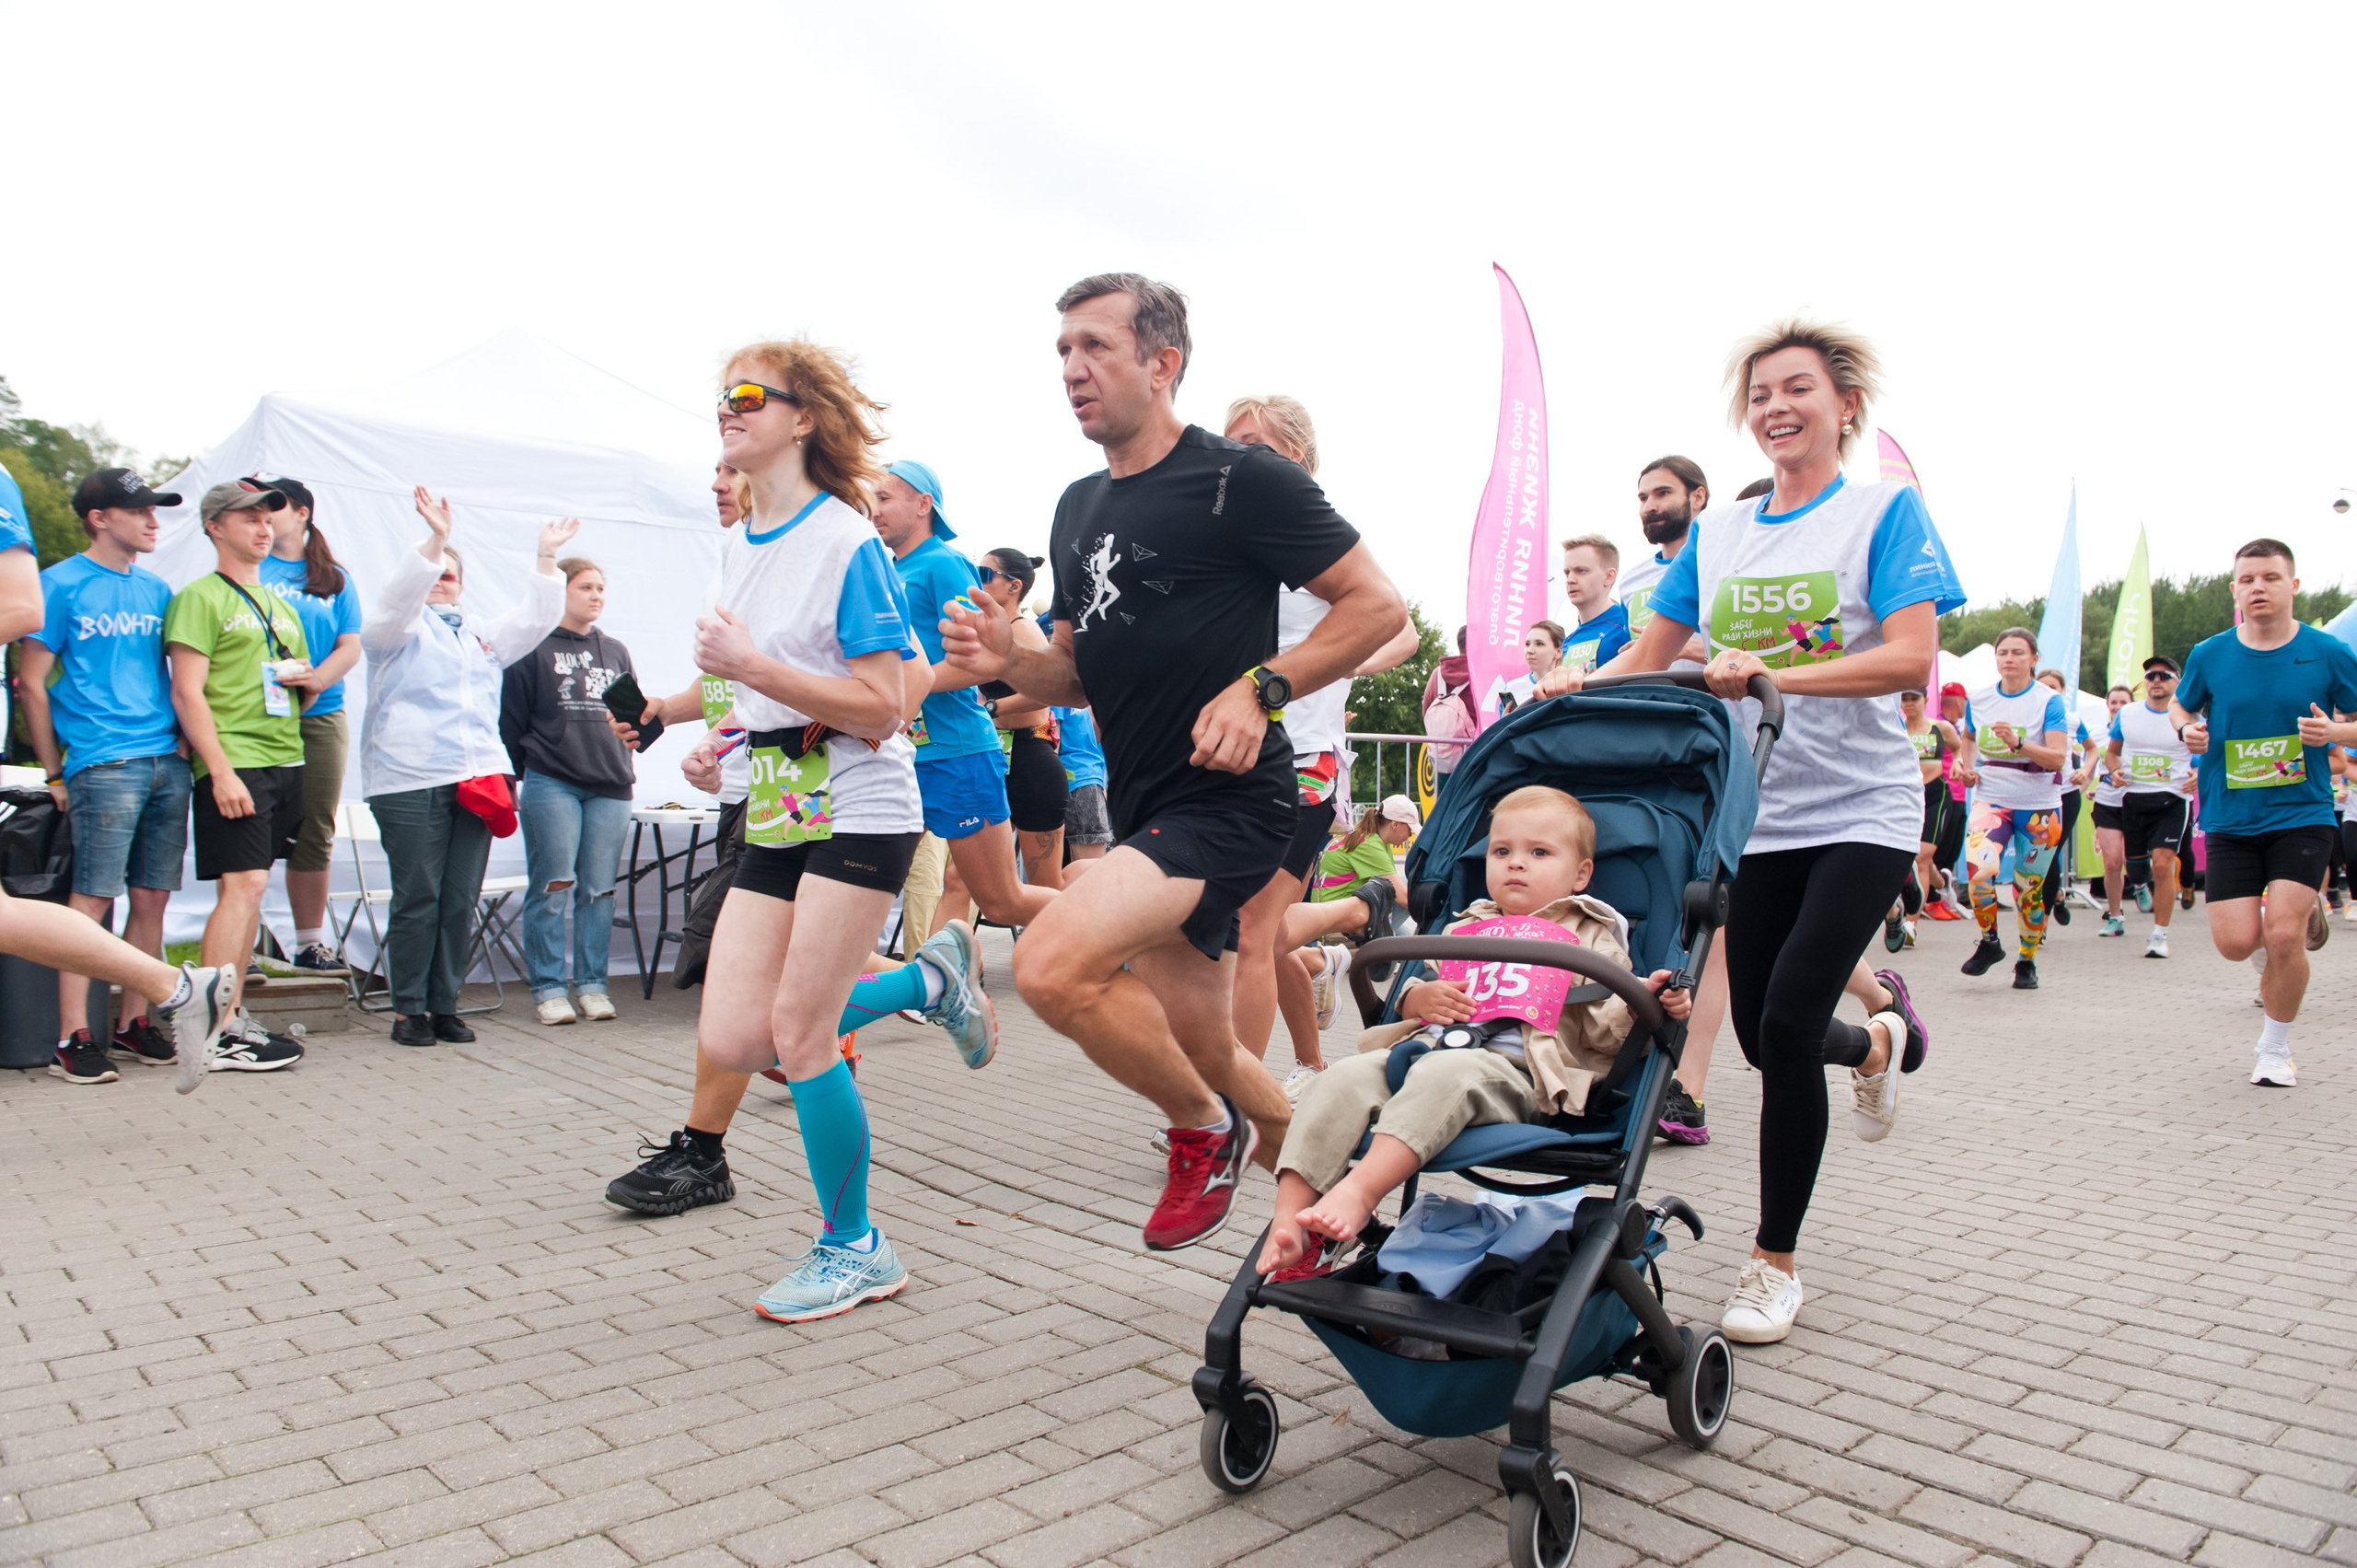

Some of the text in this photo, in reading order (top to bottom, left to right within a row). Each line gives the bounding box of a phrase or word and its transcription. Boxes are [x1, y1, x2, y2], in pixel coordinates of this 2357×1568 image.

[1212, 477, 1228, 515] Reebok
[1730, 581, 1812, 614] 1556
[1722, 627, 1772, 641] РАДИ ЖИЗНИ
[1730, 619, 1753, 632] ЗАБЕГ
[1571, 645, 1592, 659] 1330
[702, 680, 736, 703] 1385
[2235, 739, 2288, 759] 1467
[750, 755, 803, 785] 014
[2138, 757, 2164, 766] 1308
[958, 816, 980, 828] FILA
[843, 859, 877, 872] DOMYOS
[1464, 961, 1532, 1001] 135
